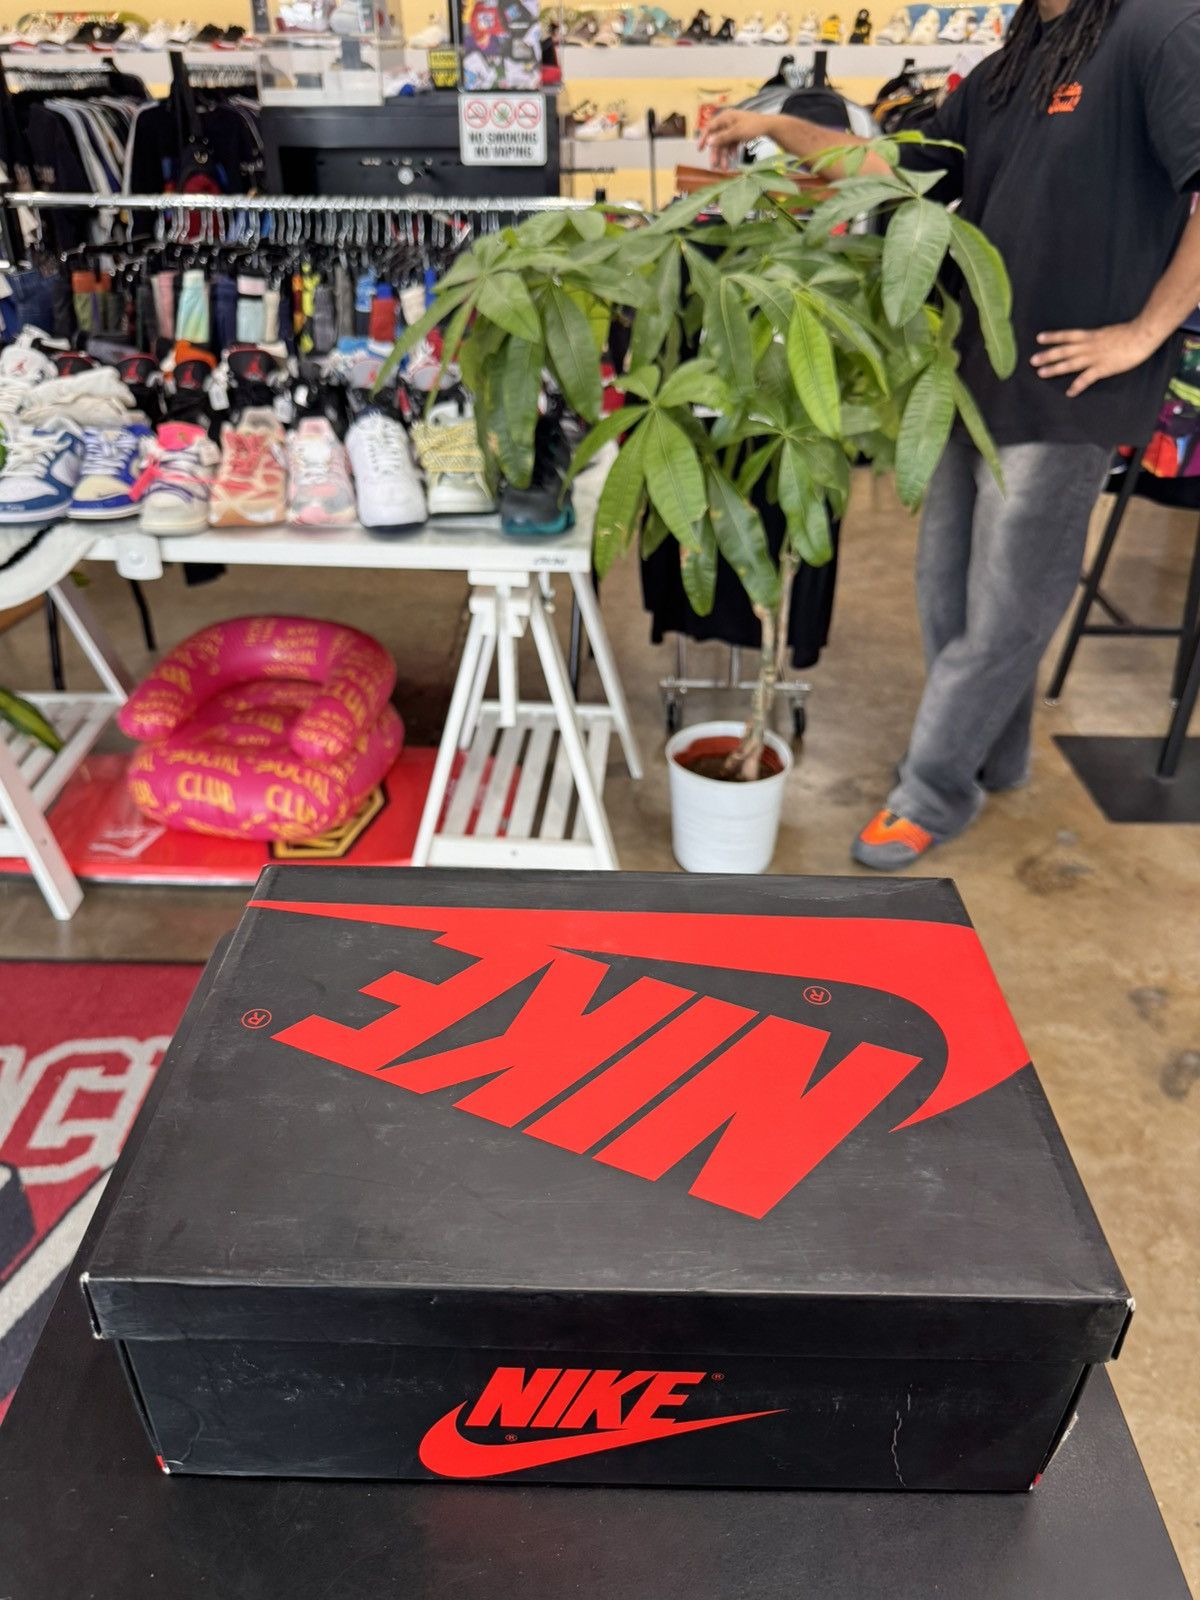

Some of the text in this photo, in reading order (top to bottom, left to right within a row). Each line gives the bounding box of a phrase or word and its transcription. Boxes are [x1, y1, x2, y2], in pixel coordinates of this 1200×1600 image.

[468, 132, 538, 143] NO SMOKING
[474, 146, 534, 158] NO VAPING
[270, 933, 923, 1219] NIKE
[465, 1367, 707, 1430] NIKE
